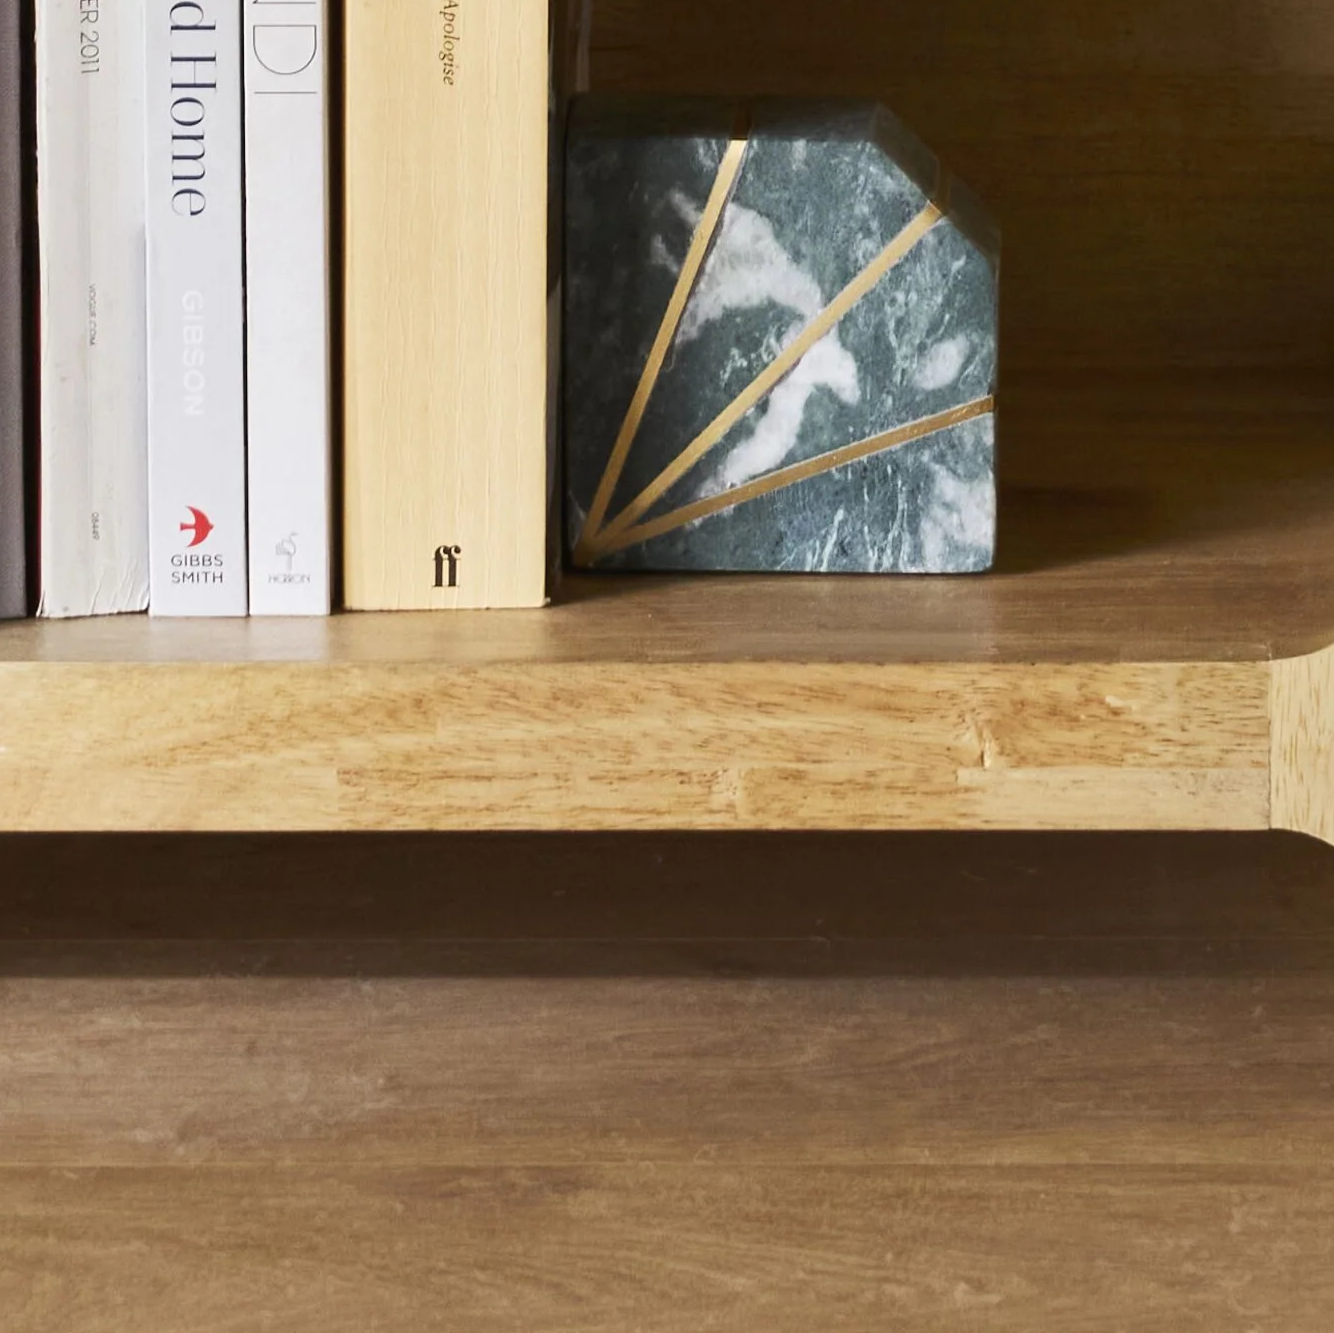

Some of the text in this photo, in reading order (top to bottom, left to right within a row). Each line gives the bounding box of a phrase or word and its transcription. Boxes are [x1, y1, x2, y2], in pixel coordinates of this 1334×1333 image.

[79, 30, 100, 75] 2011
[169, 54, 218, 217] Home
[181, 290, 206, 417] GIBSON
[170, 554, 224, 567] GIBBS
[171, 571, 224, 584] SMITH
